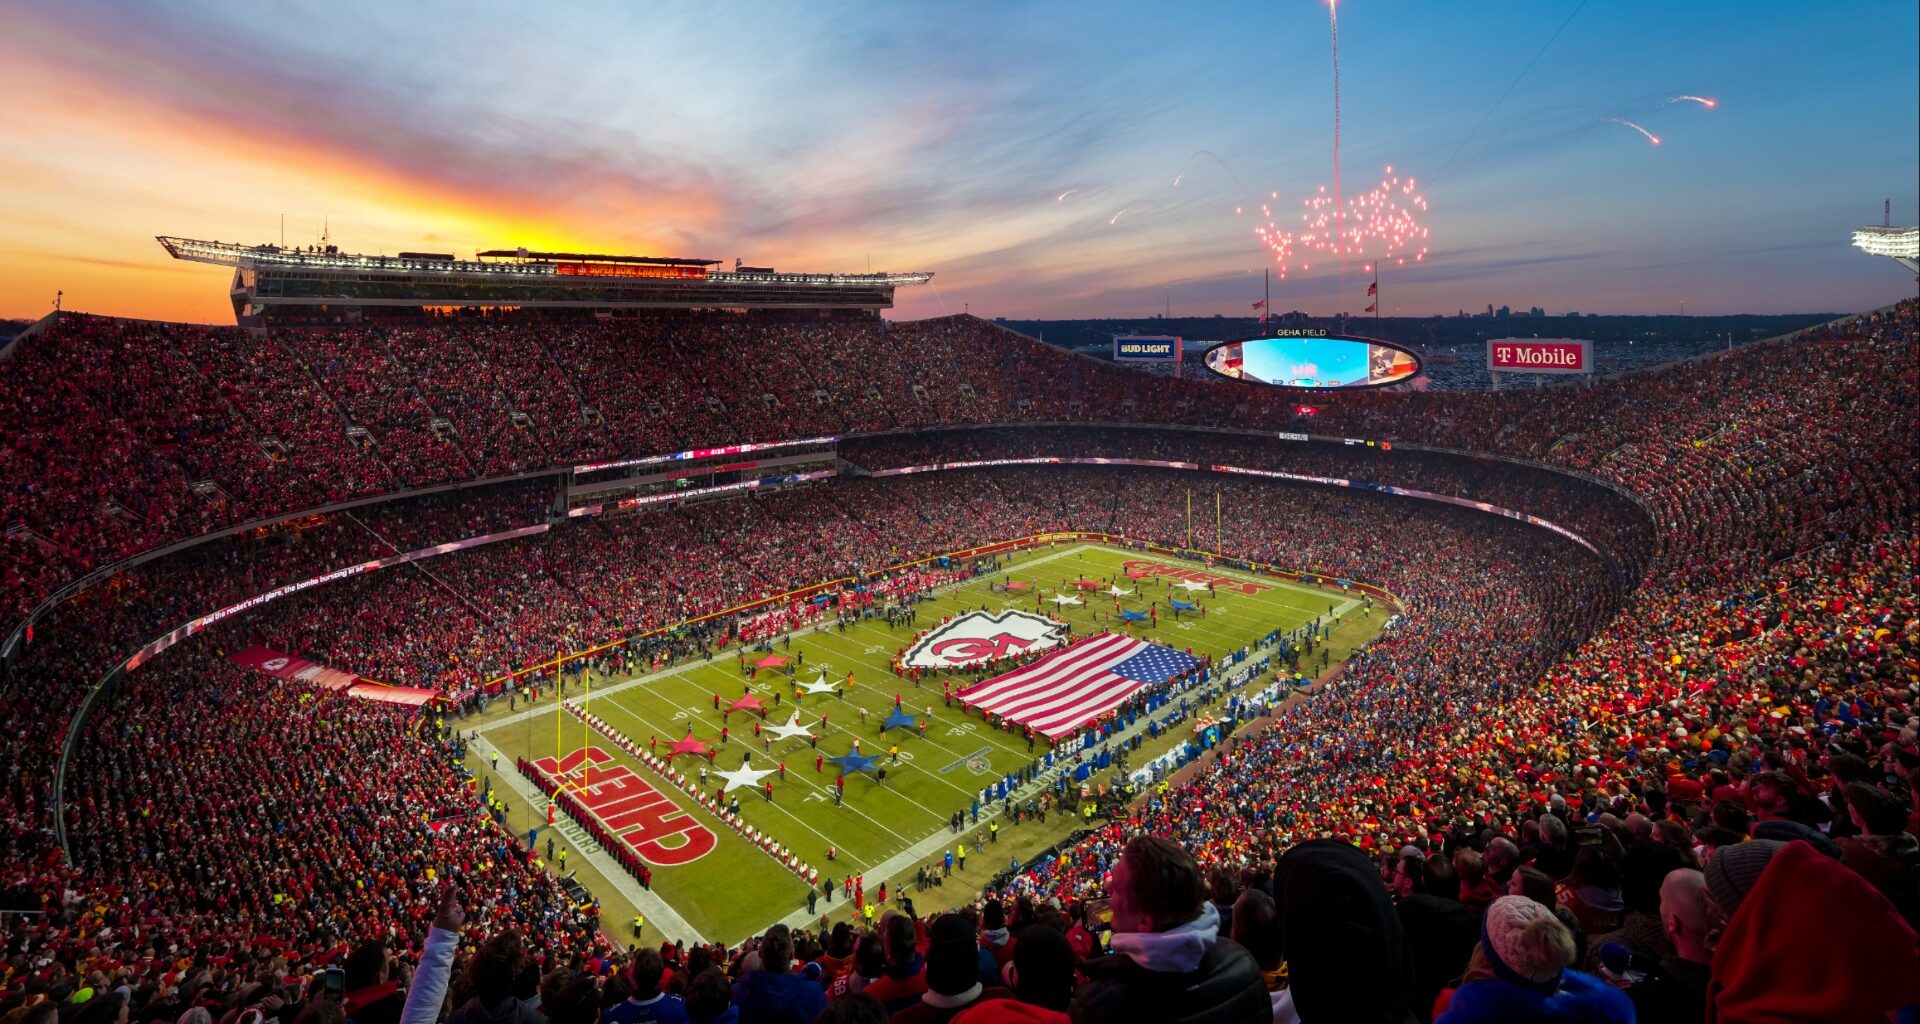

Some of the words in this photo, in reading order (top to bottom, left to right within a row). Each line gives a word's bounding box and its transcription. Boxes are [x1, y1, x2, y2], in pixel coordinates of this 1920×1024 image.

[1277, 329, 1300, 337] GEHA
[1302, 329, 1327, 337] FIELD
[1121, 344, 1142, 353] BUD
[1142, 344, 1170, 353] LIGHT
[1497, 347, 1511, 363] T
[1516, 347, 1577, 365] Mobile
[203, 617, 214, 626] And
[215, 612, 225, 620] the
[226, 601, 252, 615] rocket's
[253, 595, 264, 605] red
[265, 590, 283, 602] glare,
[284, 585, 295, 594] the
[297, 578, 318, 591] bombs
[320, 570, 347, 583] bursting
[356, 565, 365, 573] air
[949, 722, 977, 736] 30
[531, 746, 718, 867] CHIEFS
